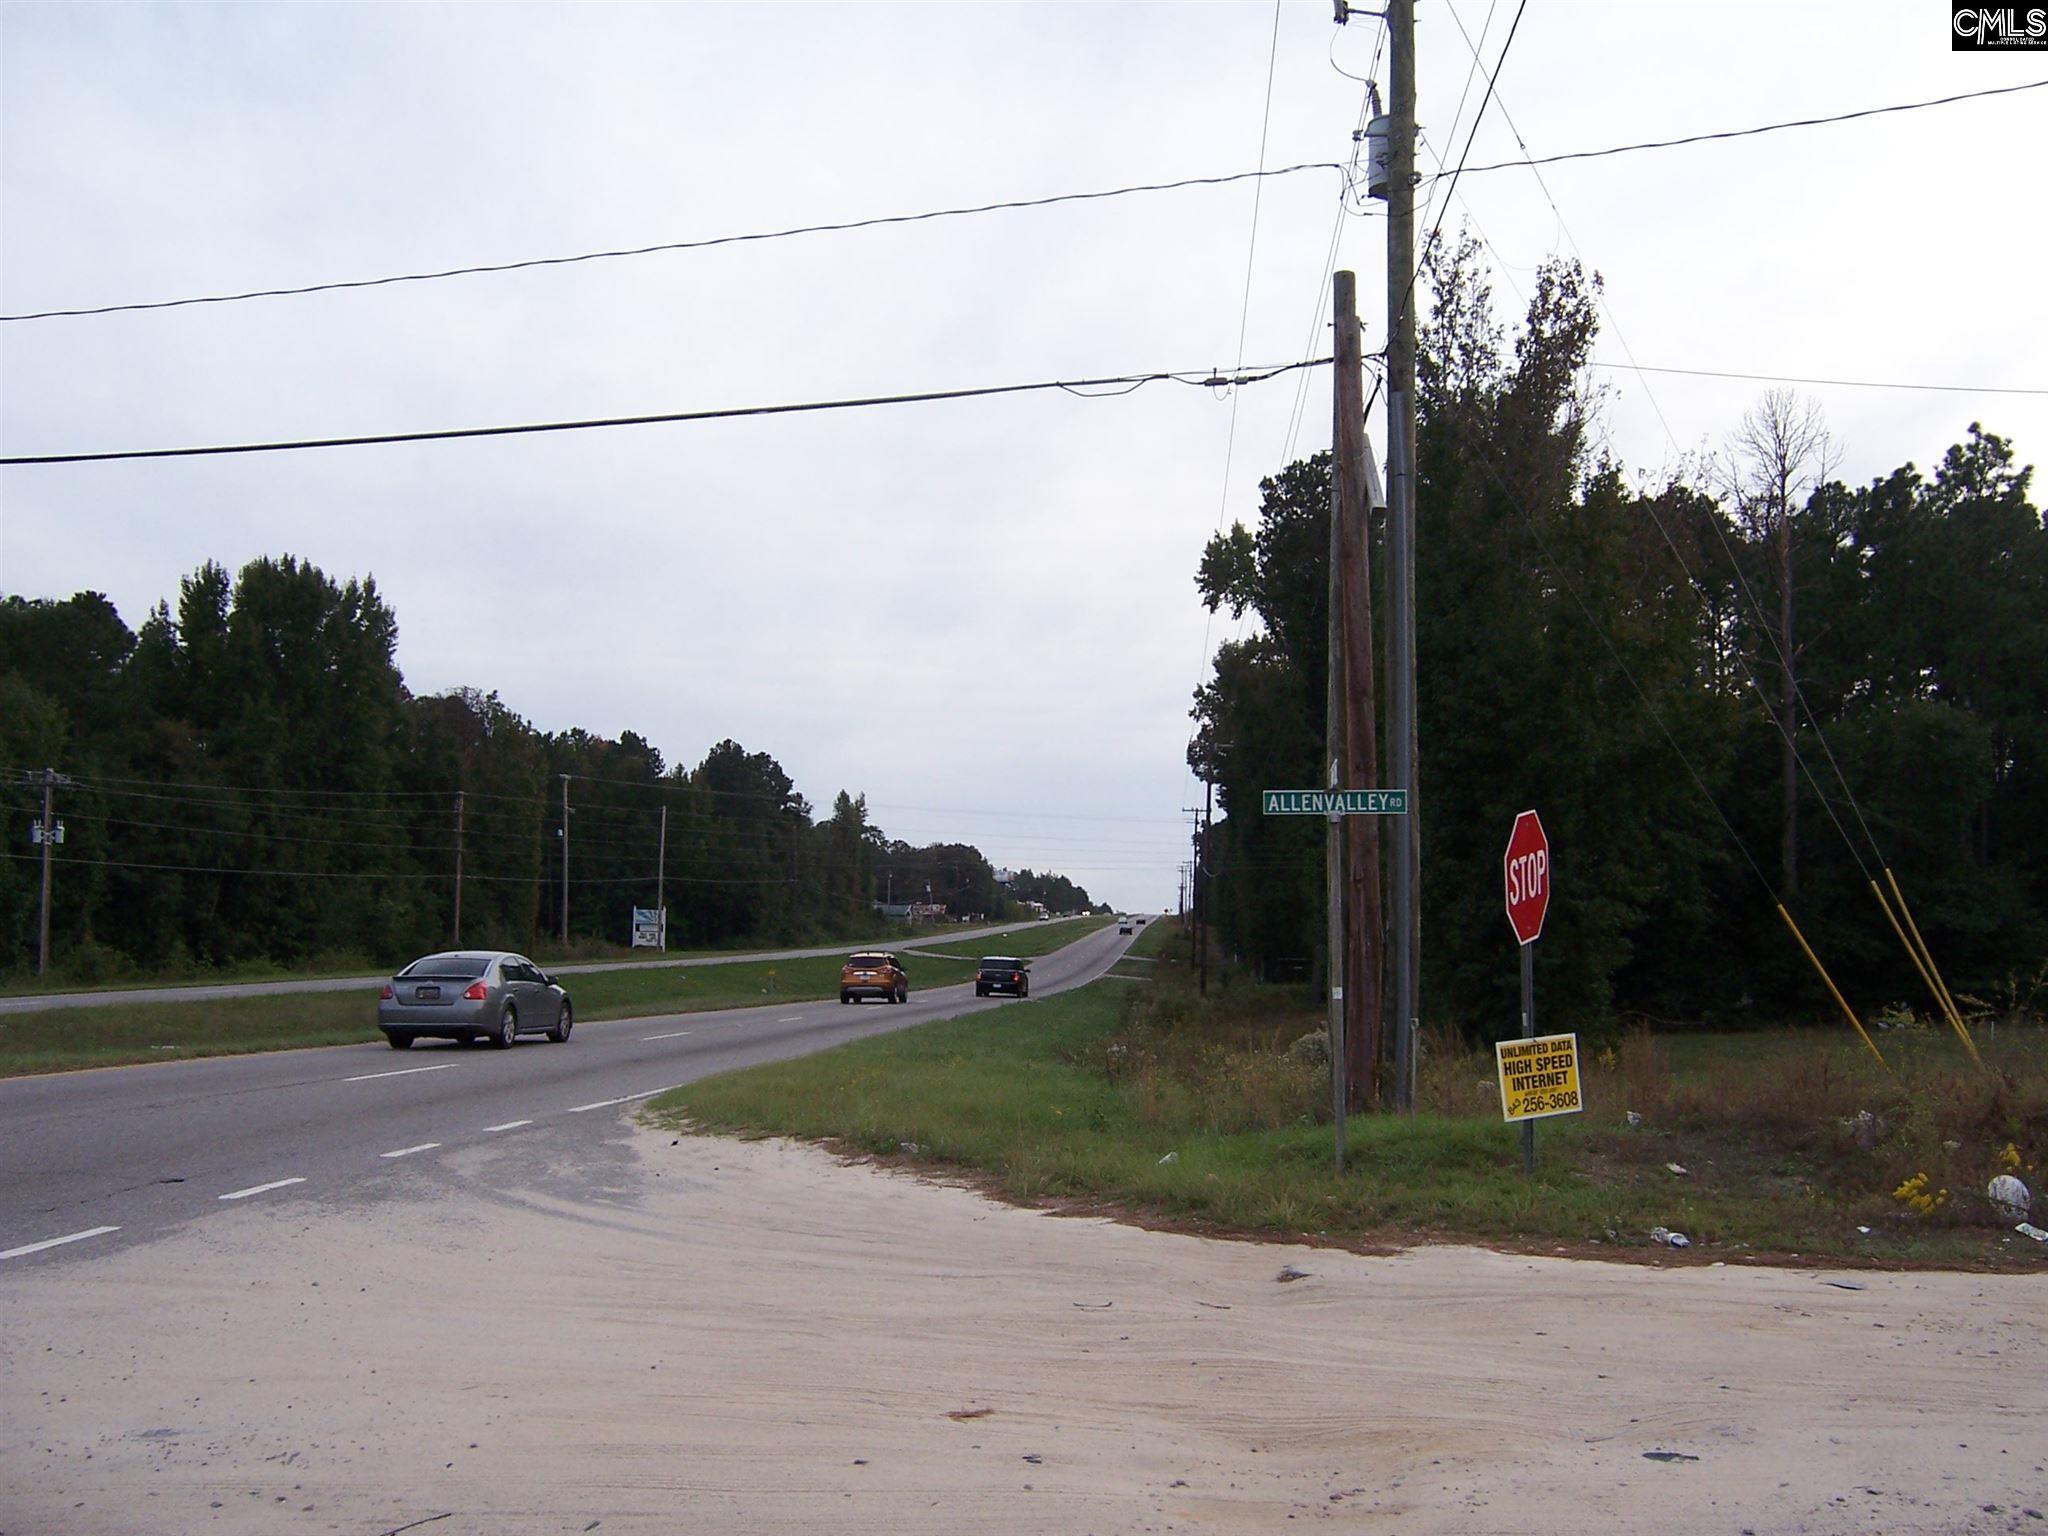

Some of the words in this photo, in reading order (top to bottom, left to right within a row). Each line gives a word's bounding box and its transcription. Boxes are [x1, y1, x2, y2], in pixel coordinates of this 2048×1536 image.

[1268, 793, 1389, 812] ALLENVALLEY
[1389, 797, 1402, 808] RD
[1509, 849, 1546, 906] STOP
[1500, 1043, 1548, 1059] UNLIMITED
[1551, 1040, 1573, 1052] DATA
[1503, 1058, 1532, 1076] HIGH
[1536, 1053, 1573, 1072] SPEED
[1511, 1070, 1568, 1092] INTERNET
[1522, 1091, 1579, 1113] 256-3608
